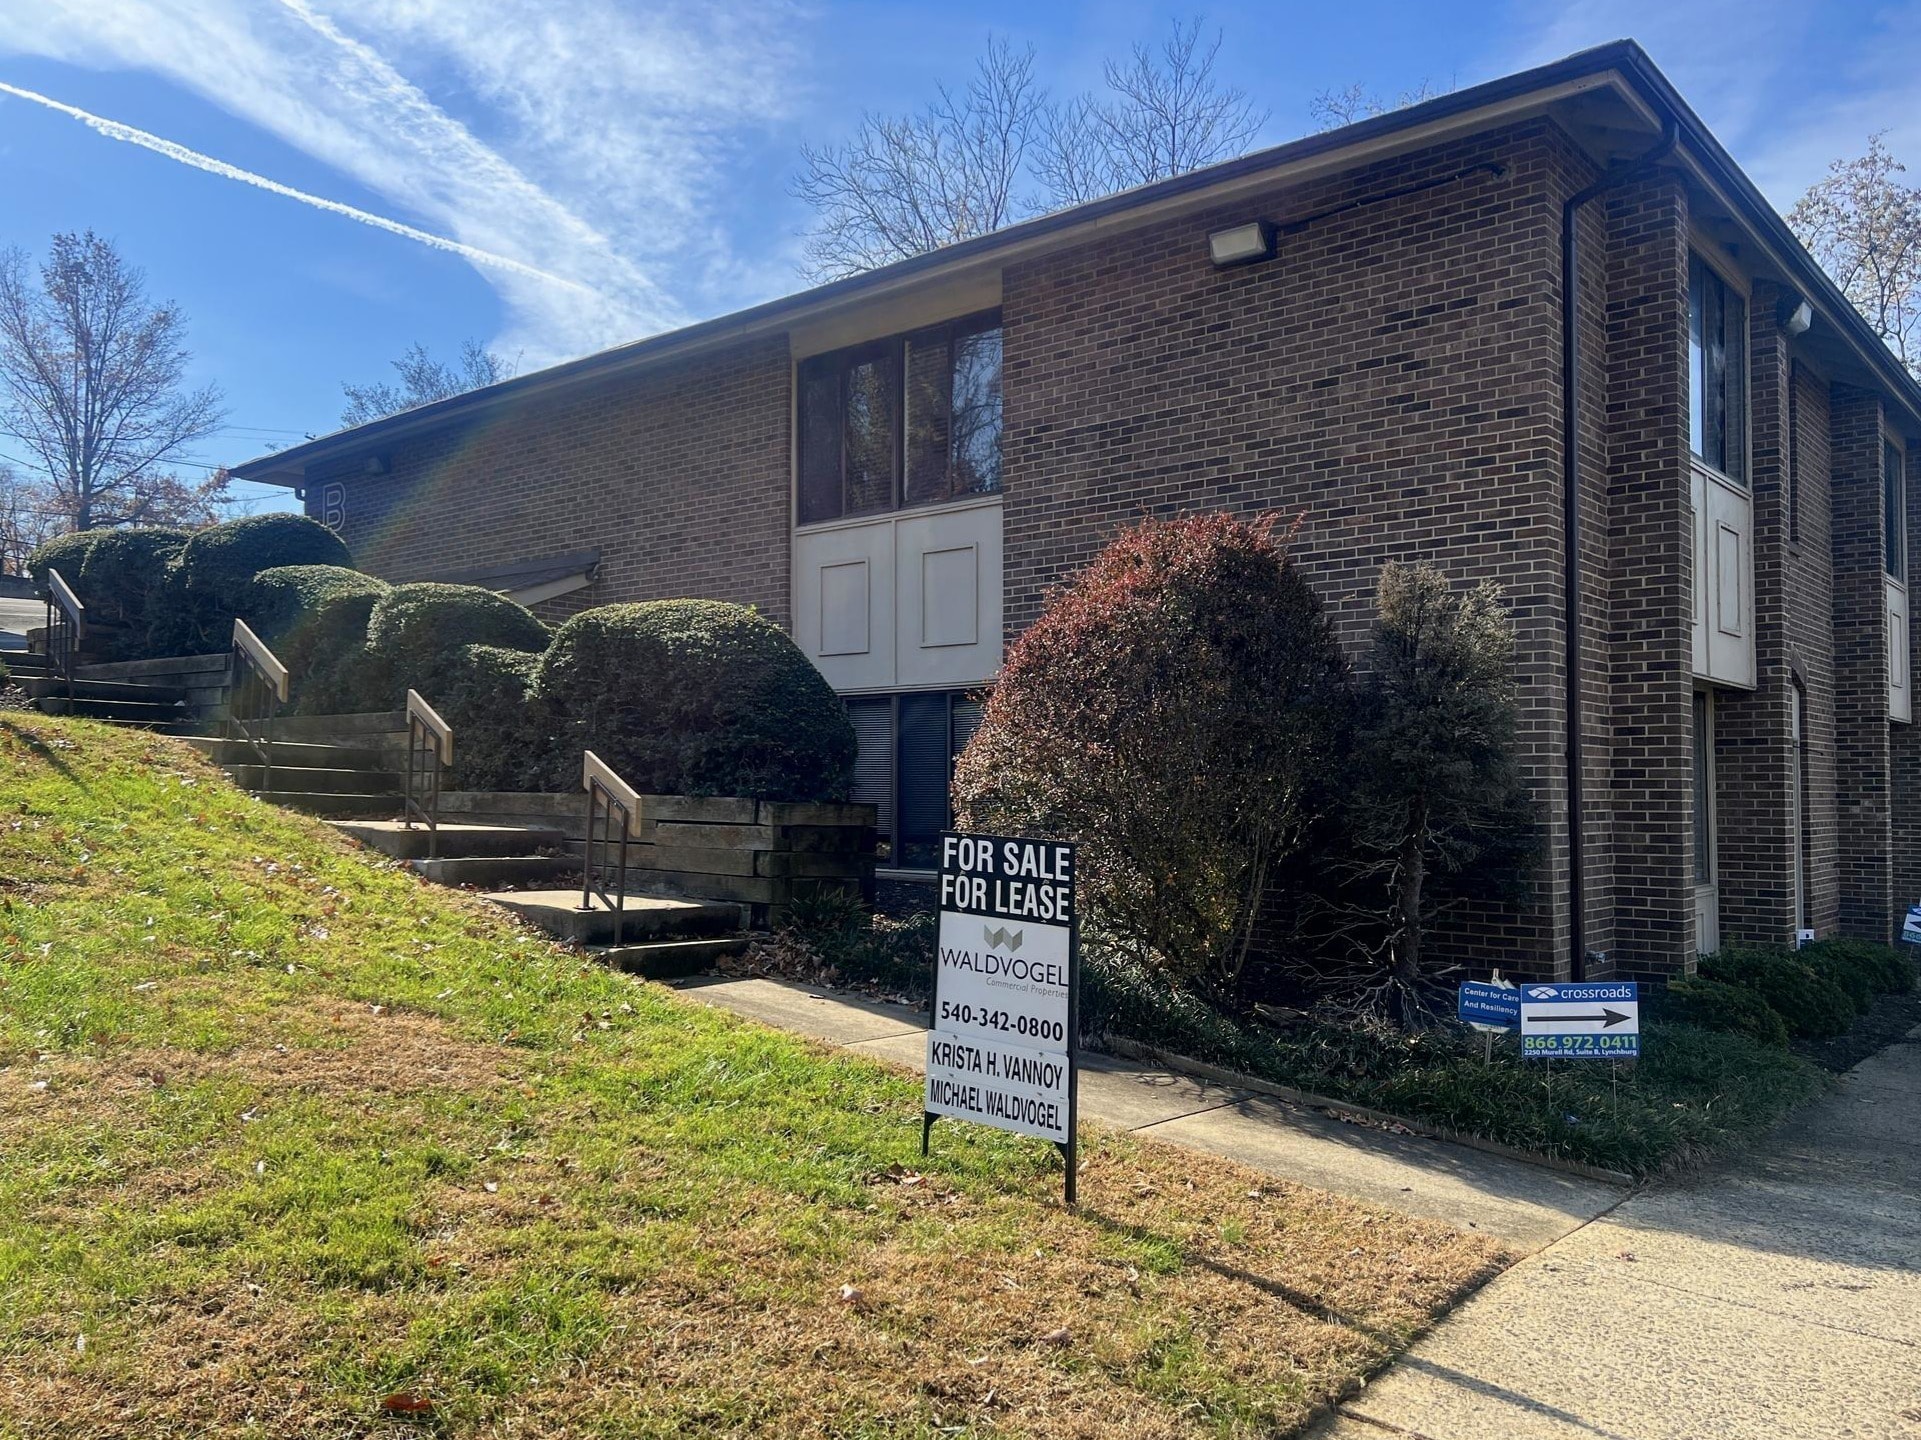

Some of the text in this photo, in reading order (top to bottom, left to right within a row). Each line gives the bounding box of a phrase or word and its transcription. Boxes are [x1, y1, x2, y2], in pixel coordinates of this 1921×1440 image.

[323, 482, 346, 532] B
[943, 837, 1070, 881] FOR SALE
[941, 874, 1070, 921] FOR LEASE
[940, 947, 1069, 987] WALDVOGEL
[986, 977, 1069, 998] Commercial Properties
[1464, 987, 1488, 997] Center
[1502, 994, 1520, 1002] Care
[1561, 986, 1632, 998] crossroads
[941, 1001, 1063, 1041] 540-342-0800
[1464, 1000, 1518, 1016] And Resiliency
[1524, 1036, 1637, 1049] 866.972.0411
[932, 1041, 1063, 1090] KRISTA H. VANNOY
[930, 1079, 1062, 1131] MICHAEL WALDVOGEL
